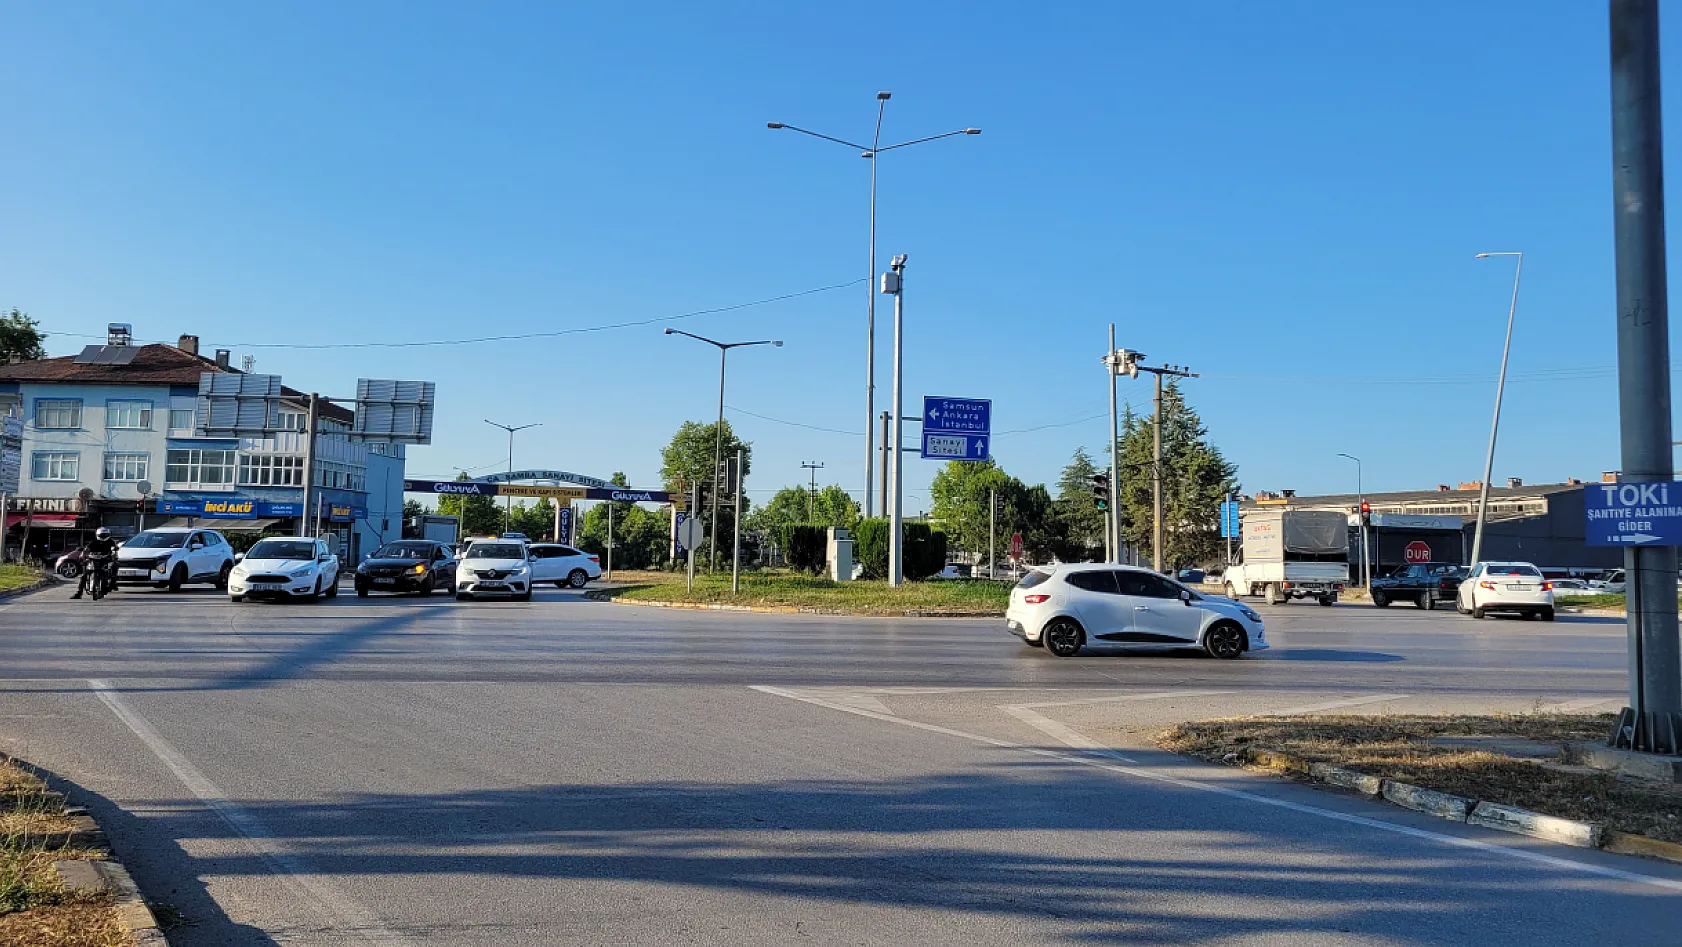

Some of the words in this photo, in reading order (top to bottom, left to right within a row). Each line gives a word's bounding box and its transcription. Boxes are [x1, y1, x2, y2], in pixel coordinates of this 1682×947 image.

[943, 402, 984, 411] Samsun
[943, 411, 979, 420] Ankara
[942, 418, 984, 430] İstanbul
[930, 438, 965, 447] Sanayi
[933, 446, 962, 455] Sitesi
[1587, 508, 1632, 521] ŞANTİYE
[1634, 506, 1682, 517] ALANINA
[1618, 520, 1653, 532] GİDER
[1406, 548, 1429, 560] DUR
